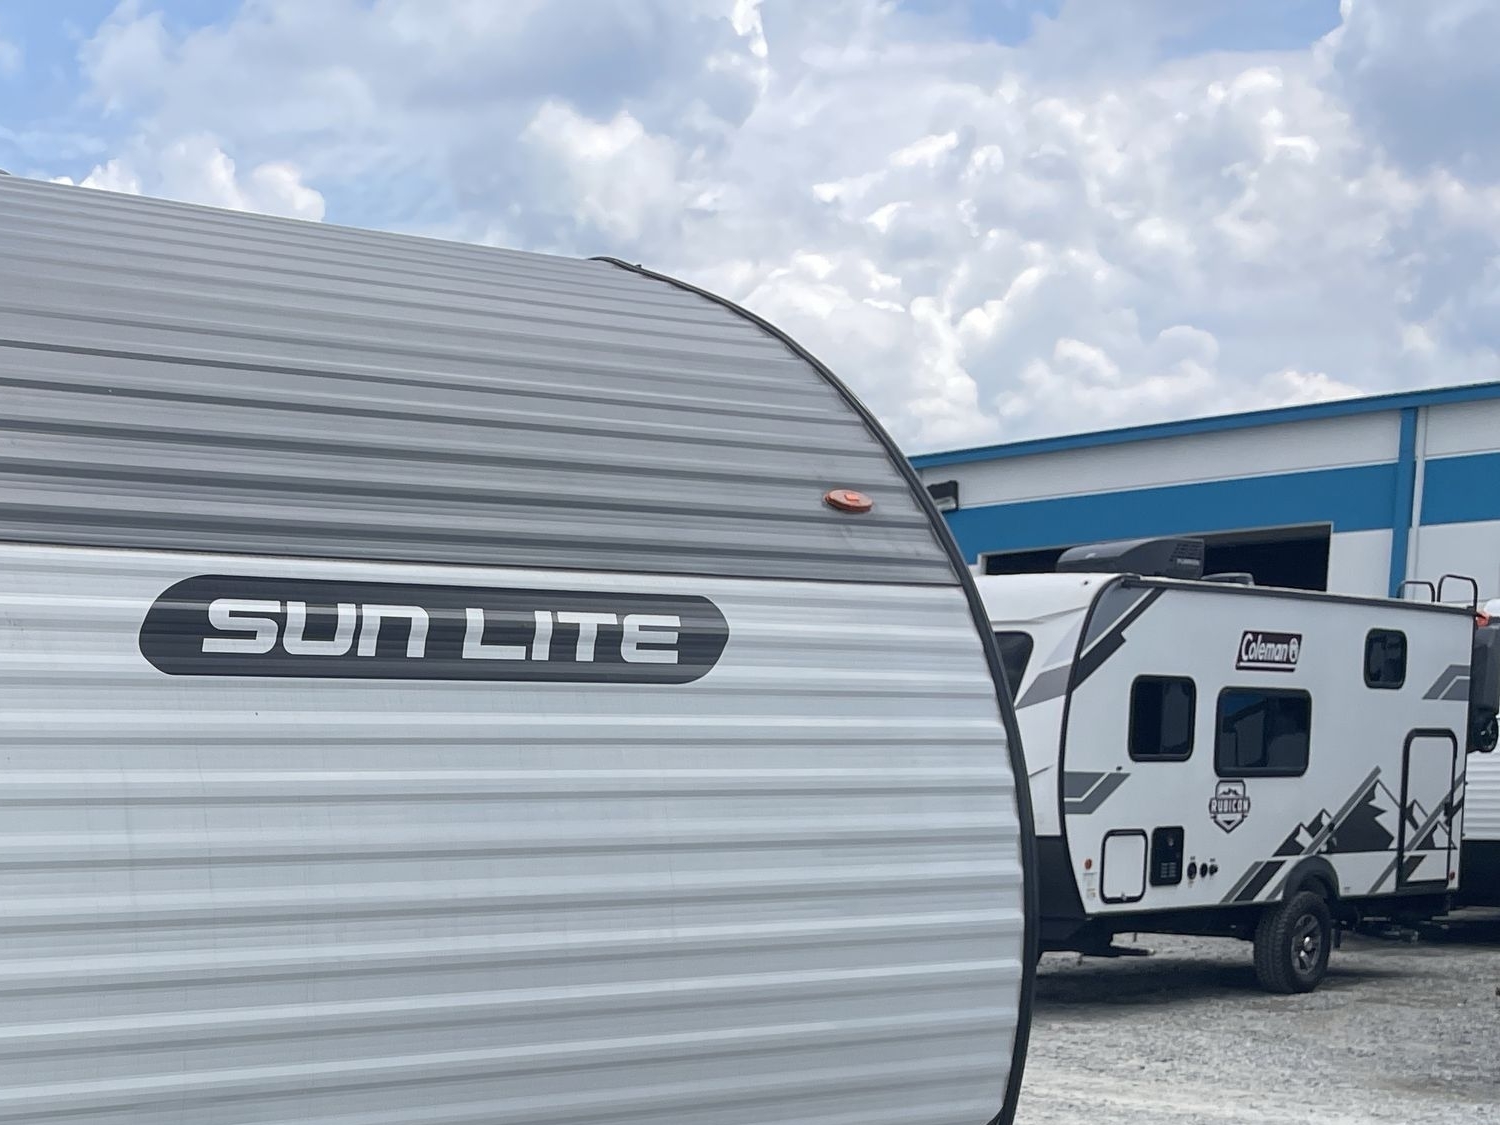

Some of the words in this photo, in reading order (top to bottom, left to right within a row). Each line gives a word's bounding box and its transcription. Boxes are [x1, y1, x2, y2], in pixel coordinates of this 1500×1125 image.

[201, 598, 430, 658] SUN
[462, 607, 682, 664] LITE
[1241, 632, 1288, 662] Coleman
[1210, 799, 1249, 812] RUBICON
